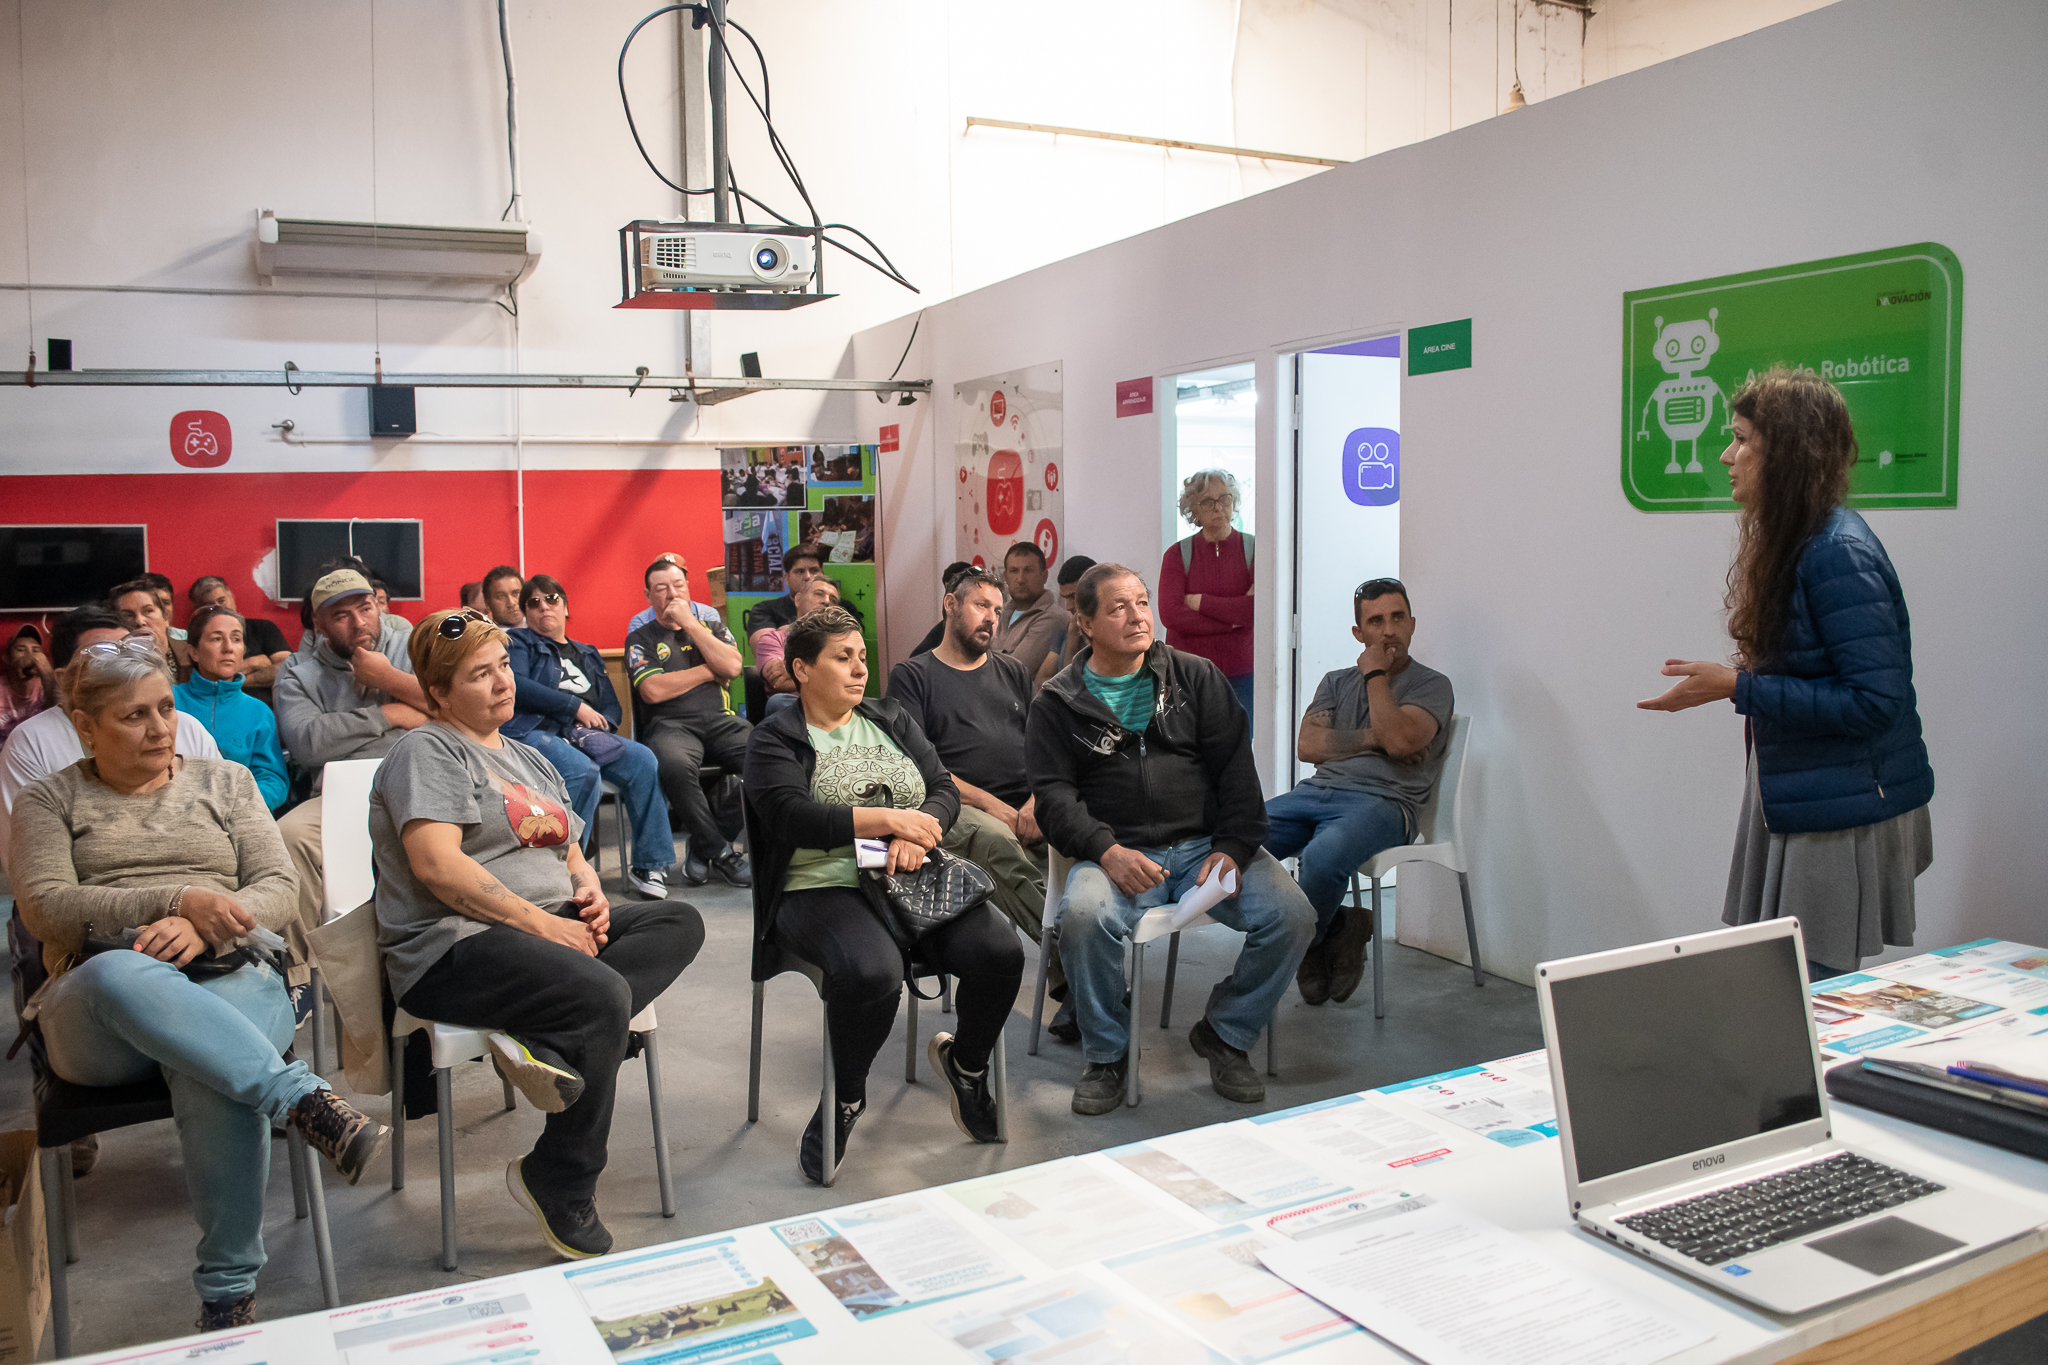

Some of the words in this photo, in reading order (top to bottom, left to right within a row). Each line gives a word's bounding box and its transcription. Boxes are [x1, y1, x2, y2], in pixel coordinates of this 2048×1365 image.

[1440, 342, 1456, 351] CINE
[1821, 354, 1910, 379] Robótica
[1692, 1154, 1725, 1171] enova
